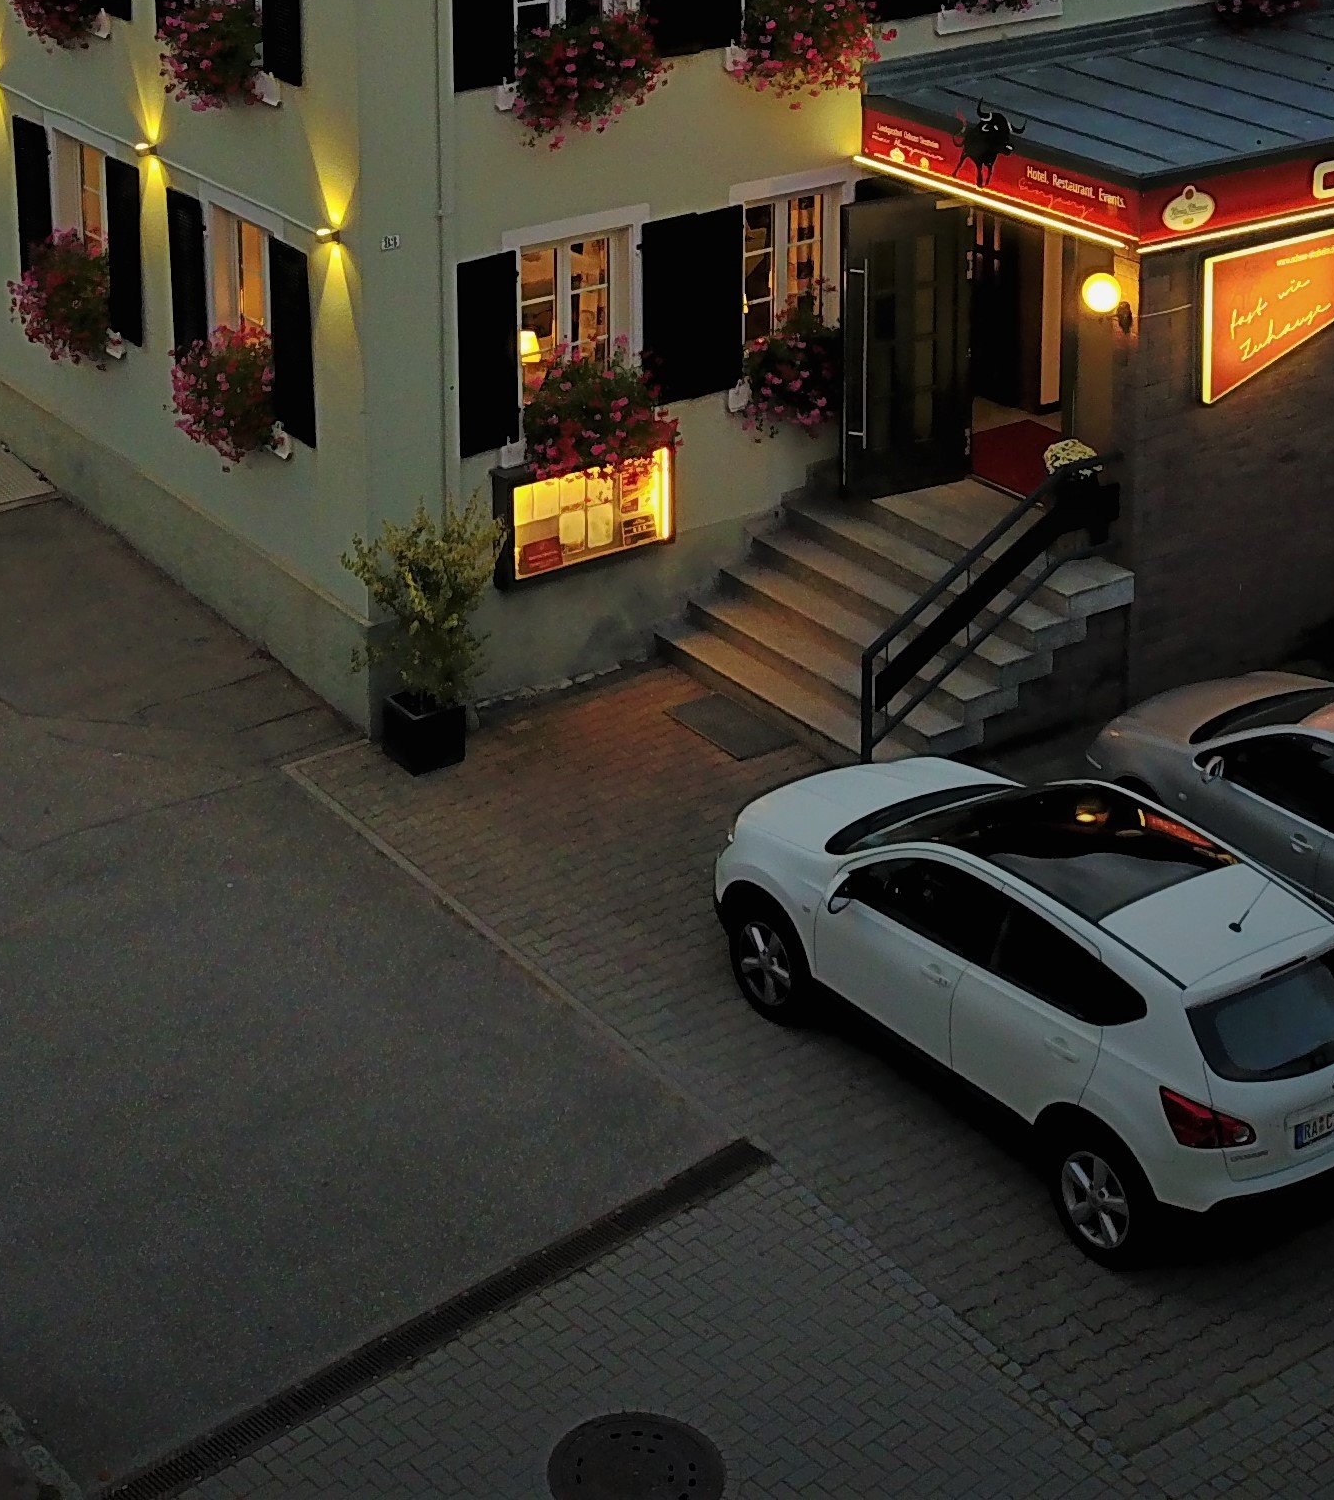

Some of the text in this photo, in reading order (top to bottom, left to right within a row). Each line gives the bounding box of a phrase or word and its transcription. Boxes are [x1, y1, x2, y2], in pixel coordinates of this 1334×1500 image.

[1229, 279, 1311, 340] fast wie
[1239, 303, 1332, 362] Zuhause
[1304, 1122, 1318, 1139] RA
